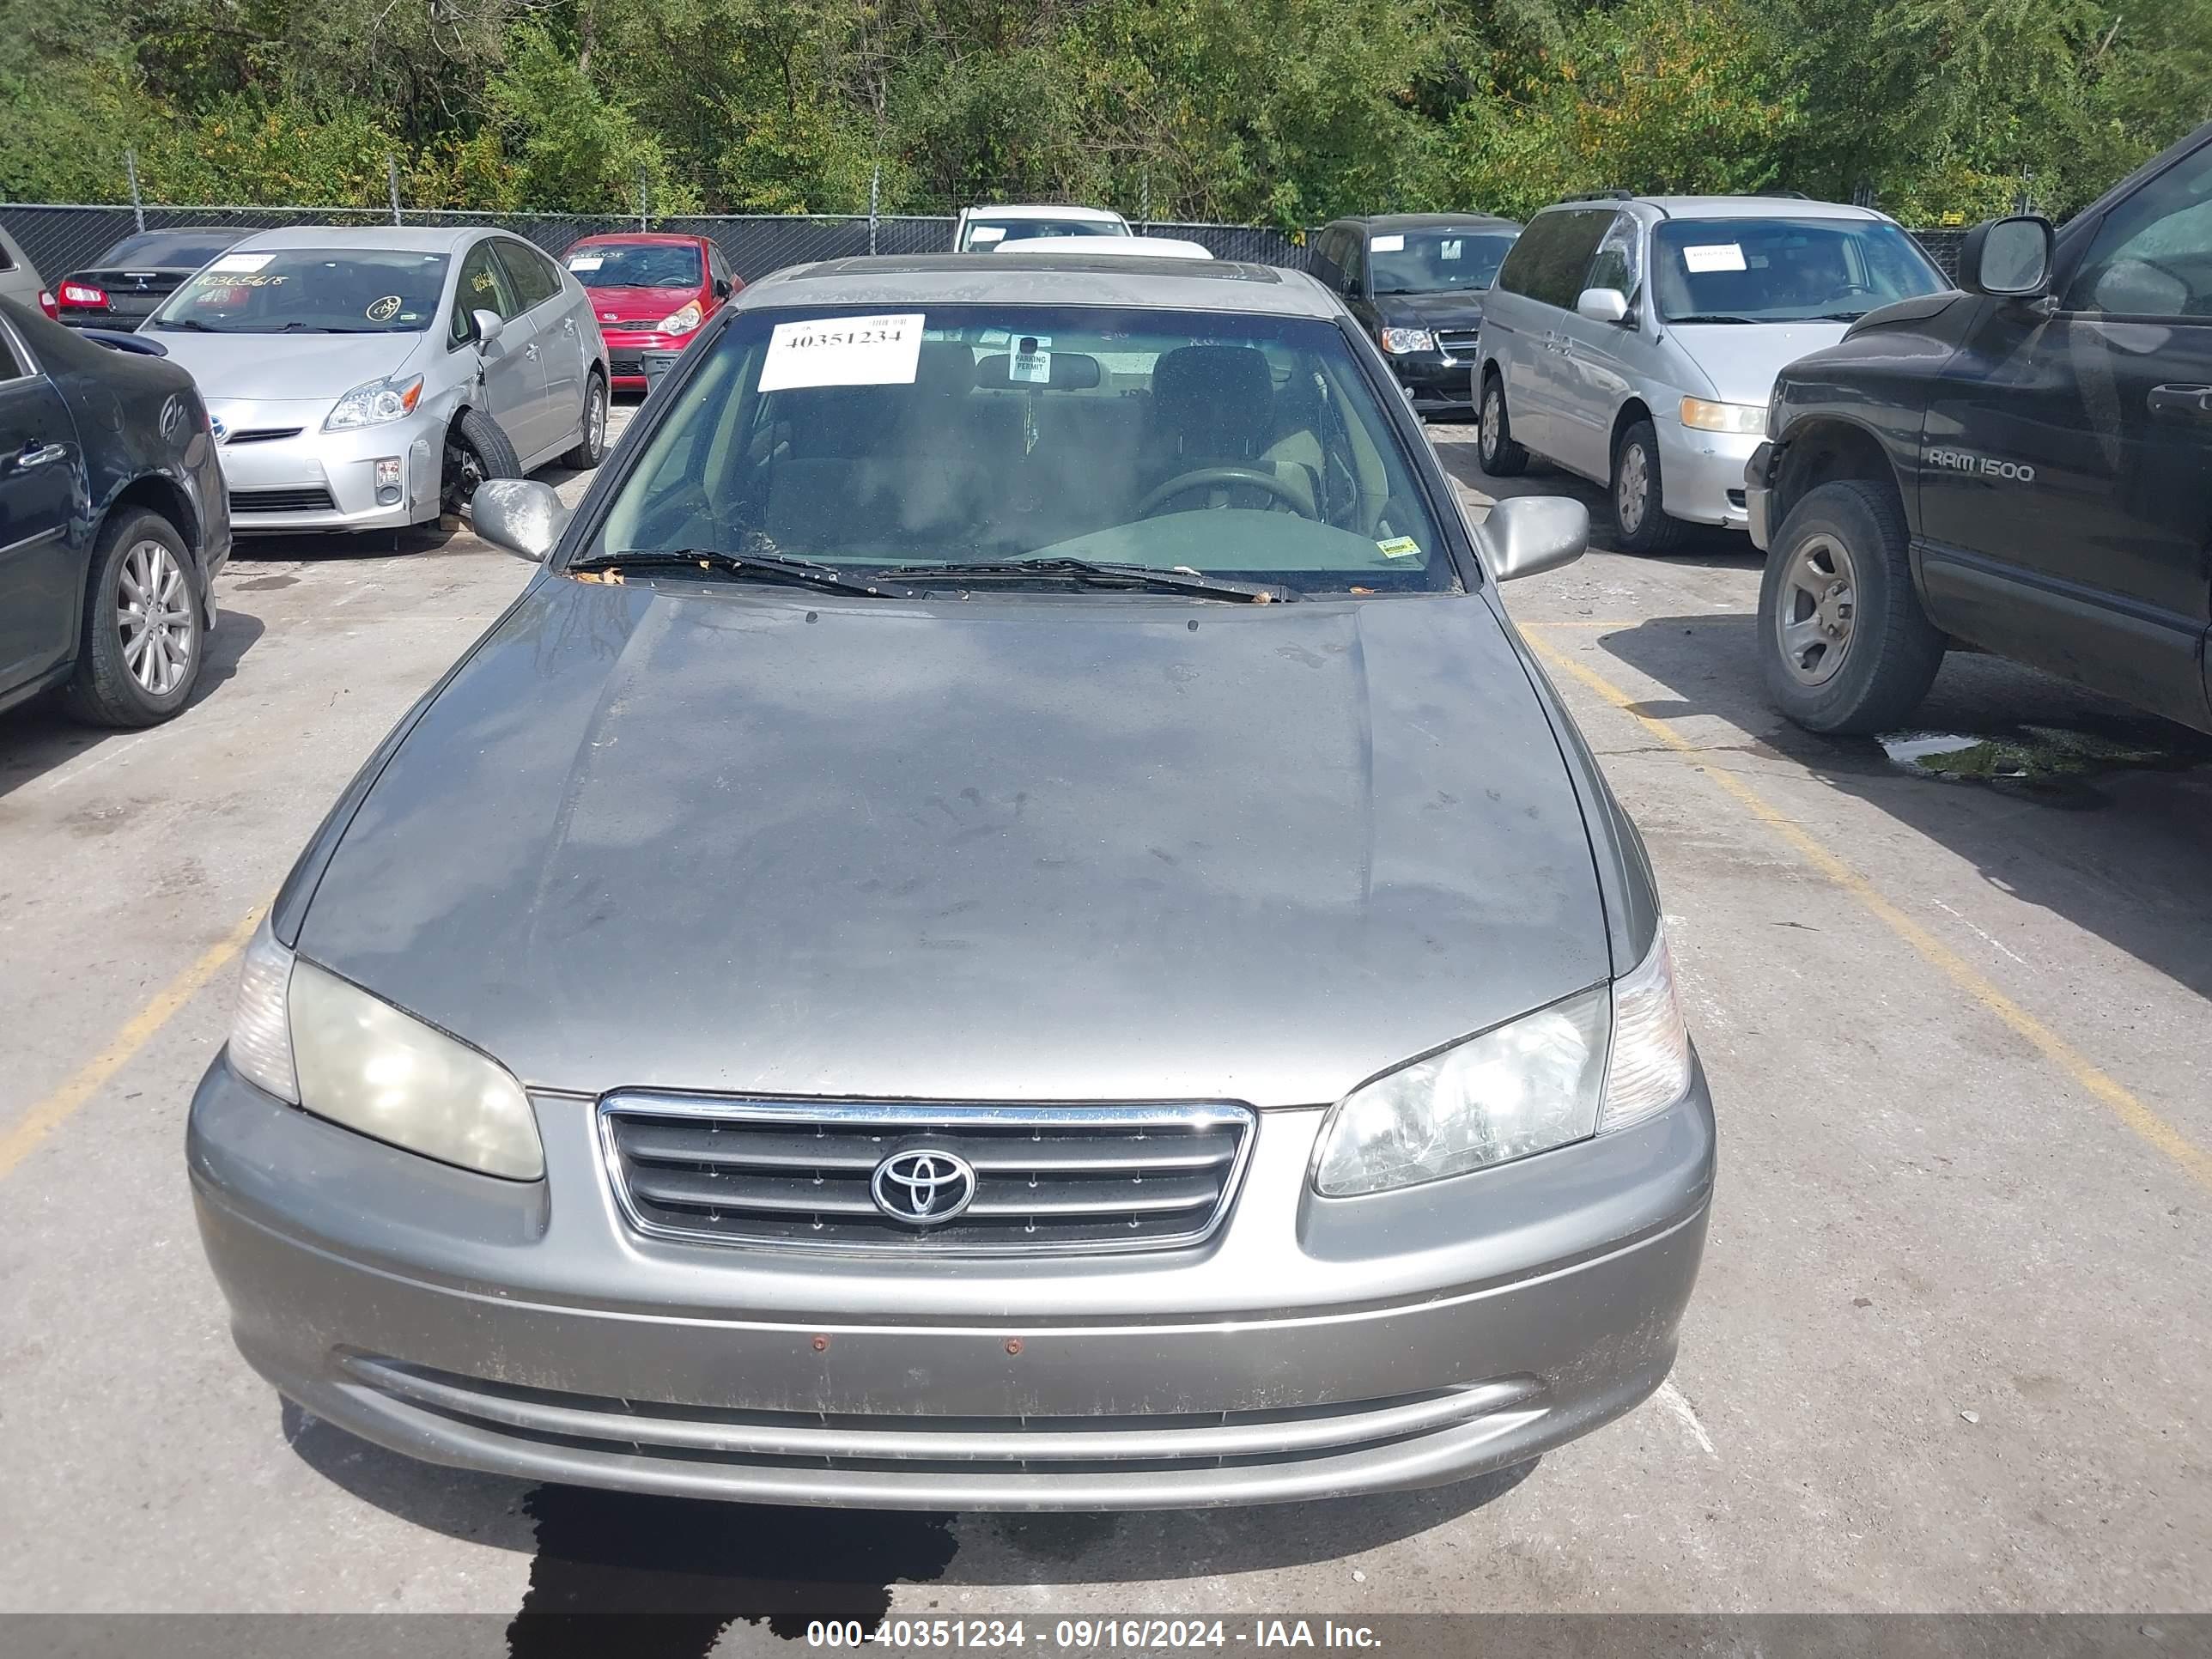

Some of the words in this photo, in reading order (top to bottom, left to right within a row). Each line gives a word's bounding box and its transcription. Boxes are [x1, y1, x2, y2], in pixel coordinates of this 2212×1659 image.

[786, 331, 902, 349] 40351234
[1016, 354, 1046, 363] PARKING
[1017, 362, 1043, 371] PERMIT
[1929, 449, 1975, 471] RAM
[1980, 458, 2036, 482] 1500
